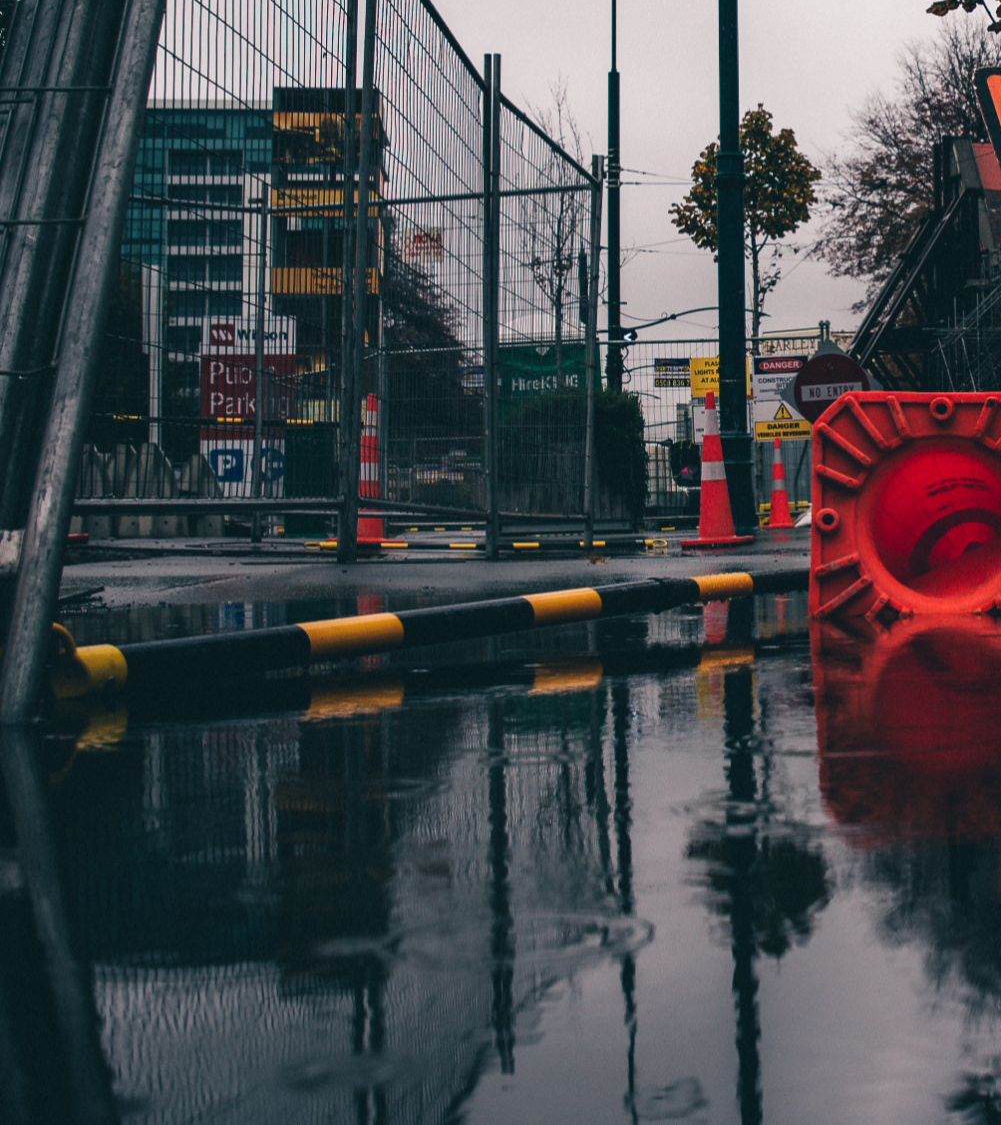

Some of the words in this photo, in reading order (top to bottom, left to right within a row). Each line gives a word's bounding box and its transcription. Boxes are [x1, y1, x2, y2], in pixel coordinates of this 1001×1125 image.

[237, 329, 288, 341] Wison
[809, 387, 821, 398] NO
[827, 385, 855, 397] ENTRY
